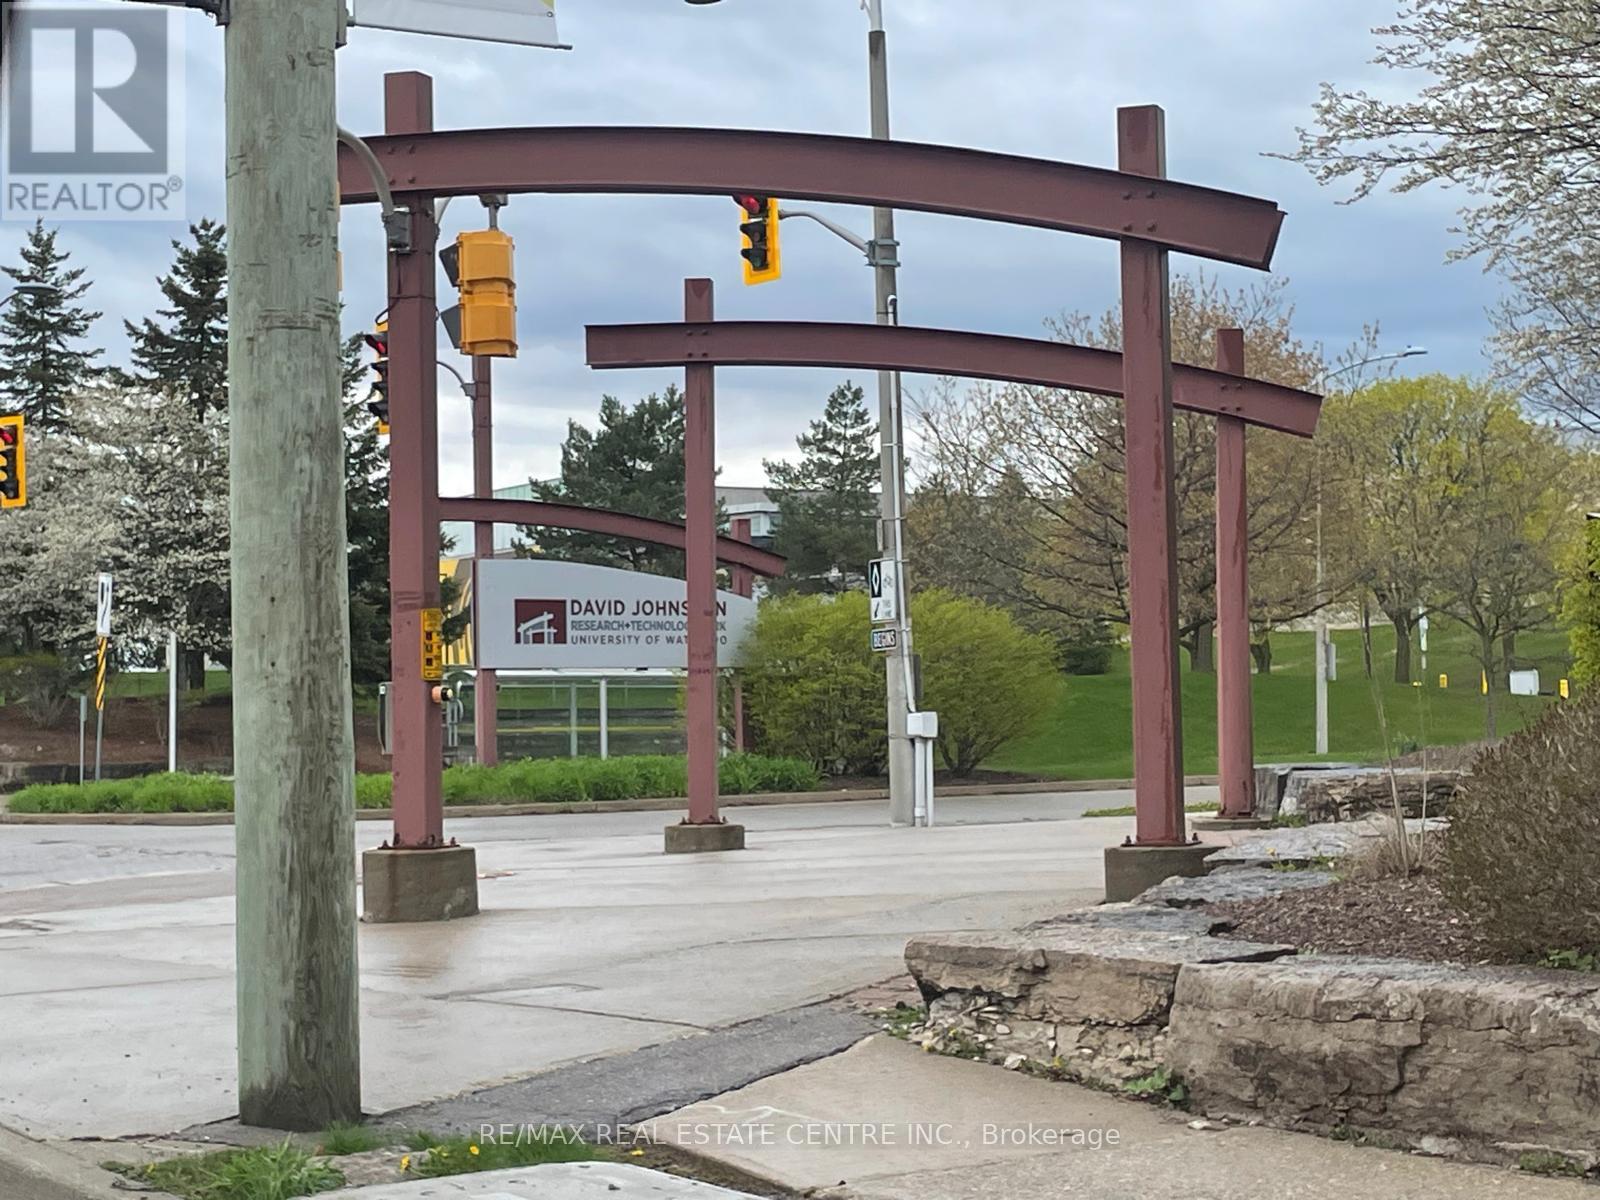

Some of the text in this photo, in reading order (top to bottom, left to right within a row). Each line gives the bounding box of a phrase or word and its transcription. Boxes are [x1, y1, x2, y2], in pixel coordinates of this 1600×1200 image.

[571, 599, 727, 616] DAVID JOHNSN
[571, 635, 641, 645] UNIVERSITY
[645, 635, 660, 645] OF
